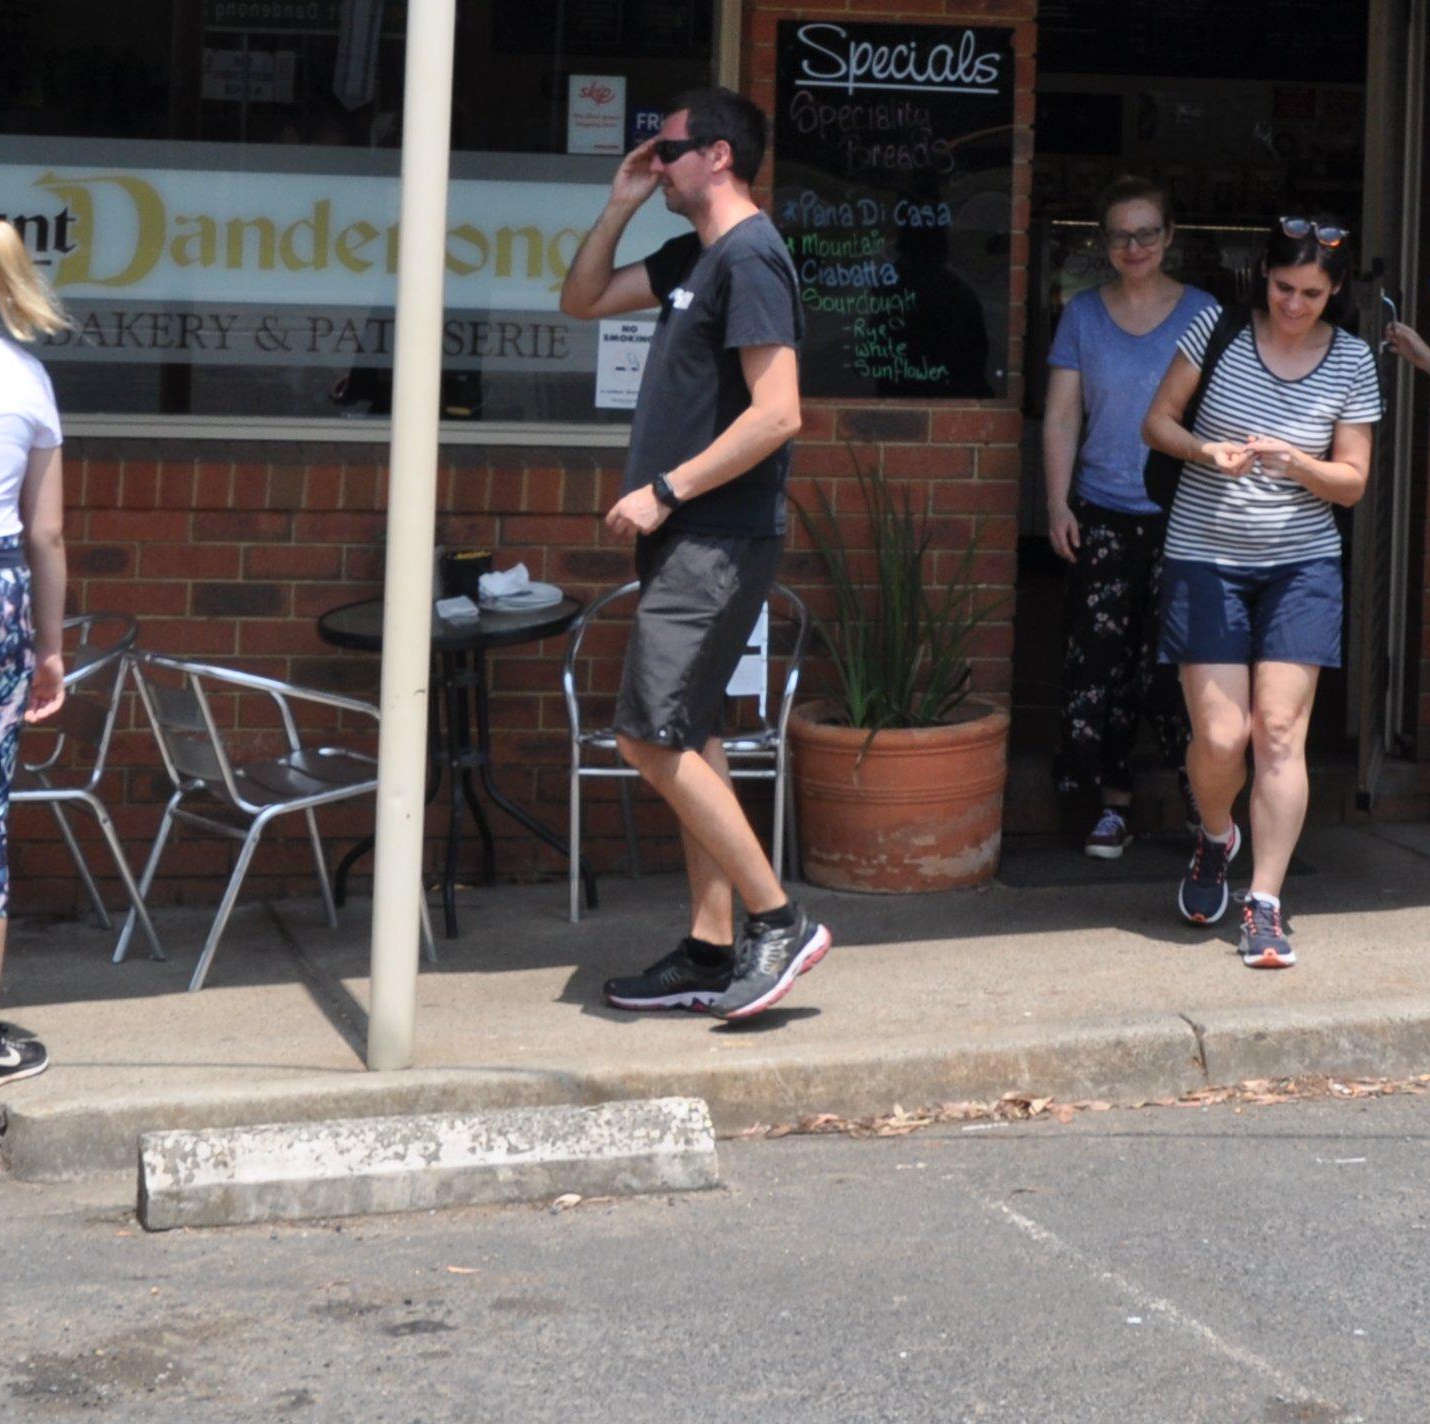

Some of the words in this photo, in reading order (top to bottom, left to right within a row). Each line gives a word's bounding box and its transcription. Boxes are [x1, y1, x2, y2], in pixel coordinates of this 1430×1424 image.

[795, 22, 1002, 95] Specials
[254, 316, 289, 352] &
[306, 317, 570, 360] PATSERIE
